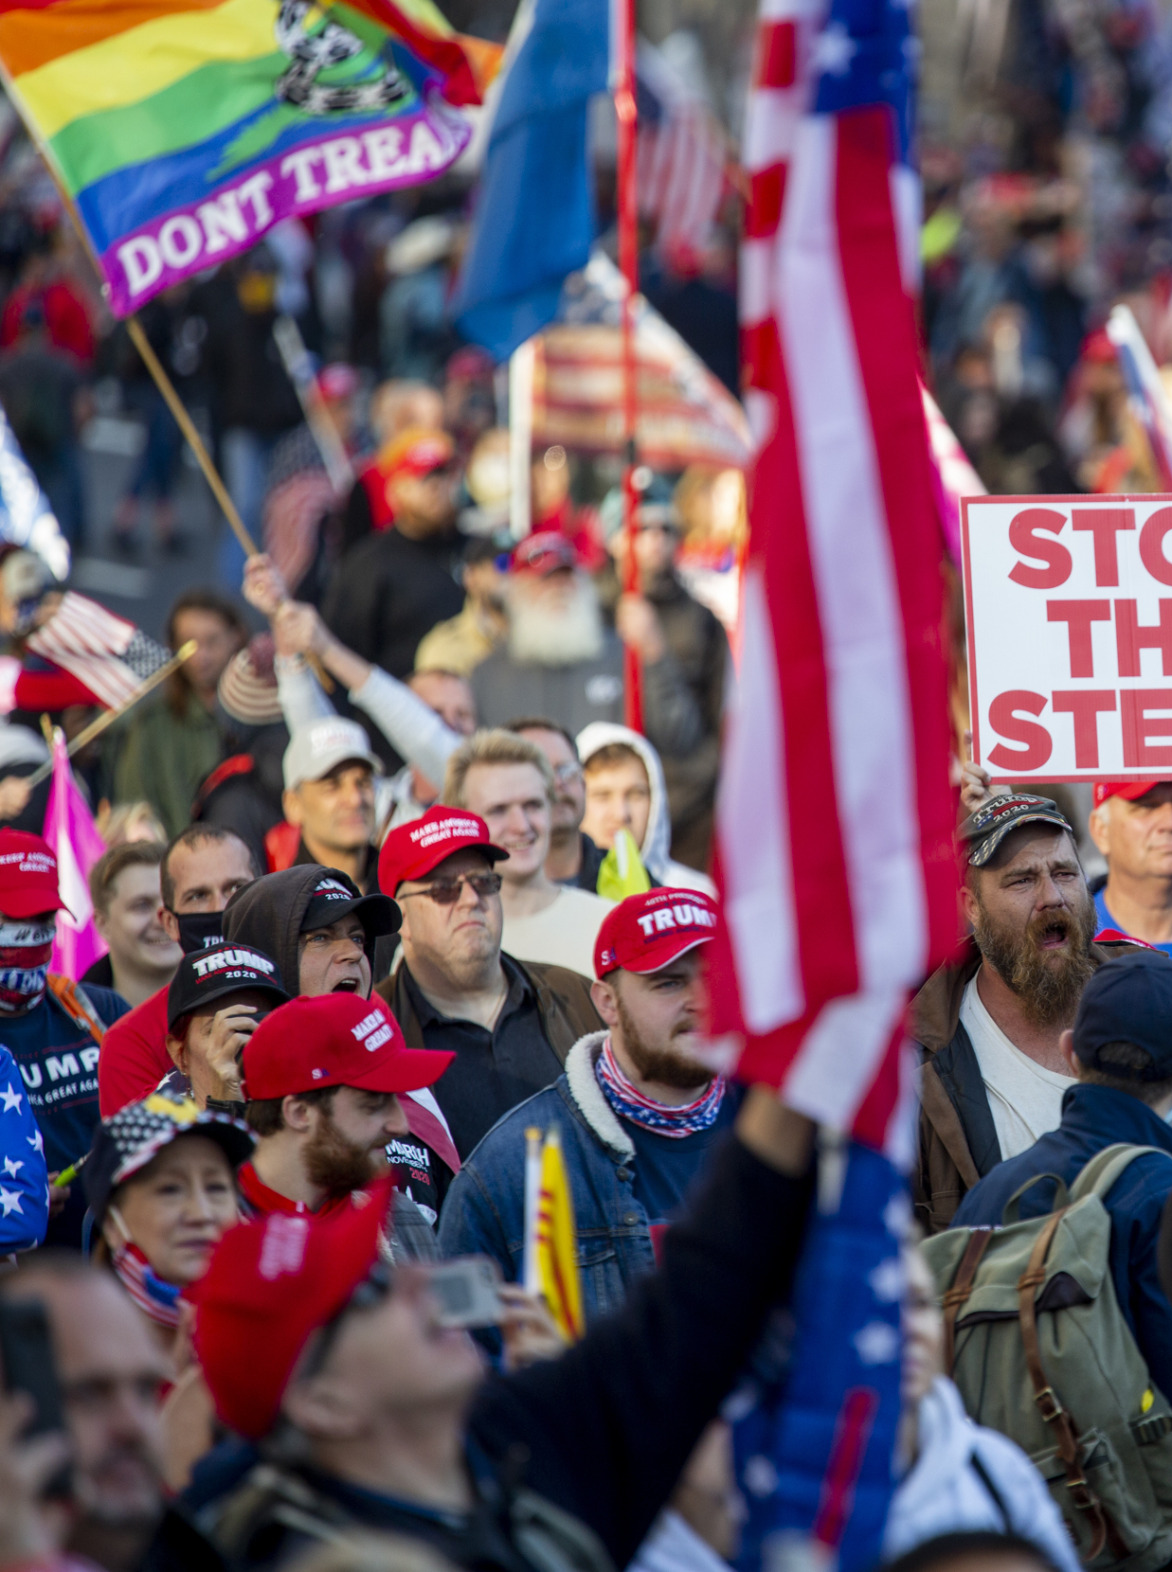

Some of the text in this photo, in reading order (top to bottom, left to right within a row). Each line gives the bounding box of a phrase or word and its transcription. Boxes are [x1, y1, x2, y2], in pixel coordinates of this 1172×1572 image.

[117, 120, 447, 297] DONT TREA
[993, 804, 1029, 823] 2020
[192, 949, 275, 977] TRUMP
[225, 970, 258, 980] 2020
[19, 1046, 100, 1089] UMP
[44, 1082, 79, 1104] GREAT
[79, 1077, 99, 1093] AGA
[385, 1139, 430, 1167] MARCH
